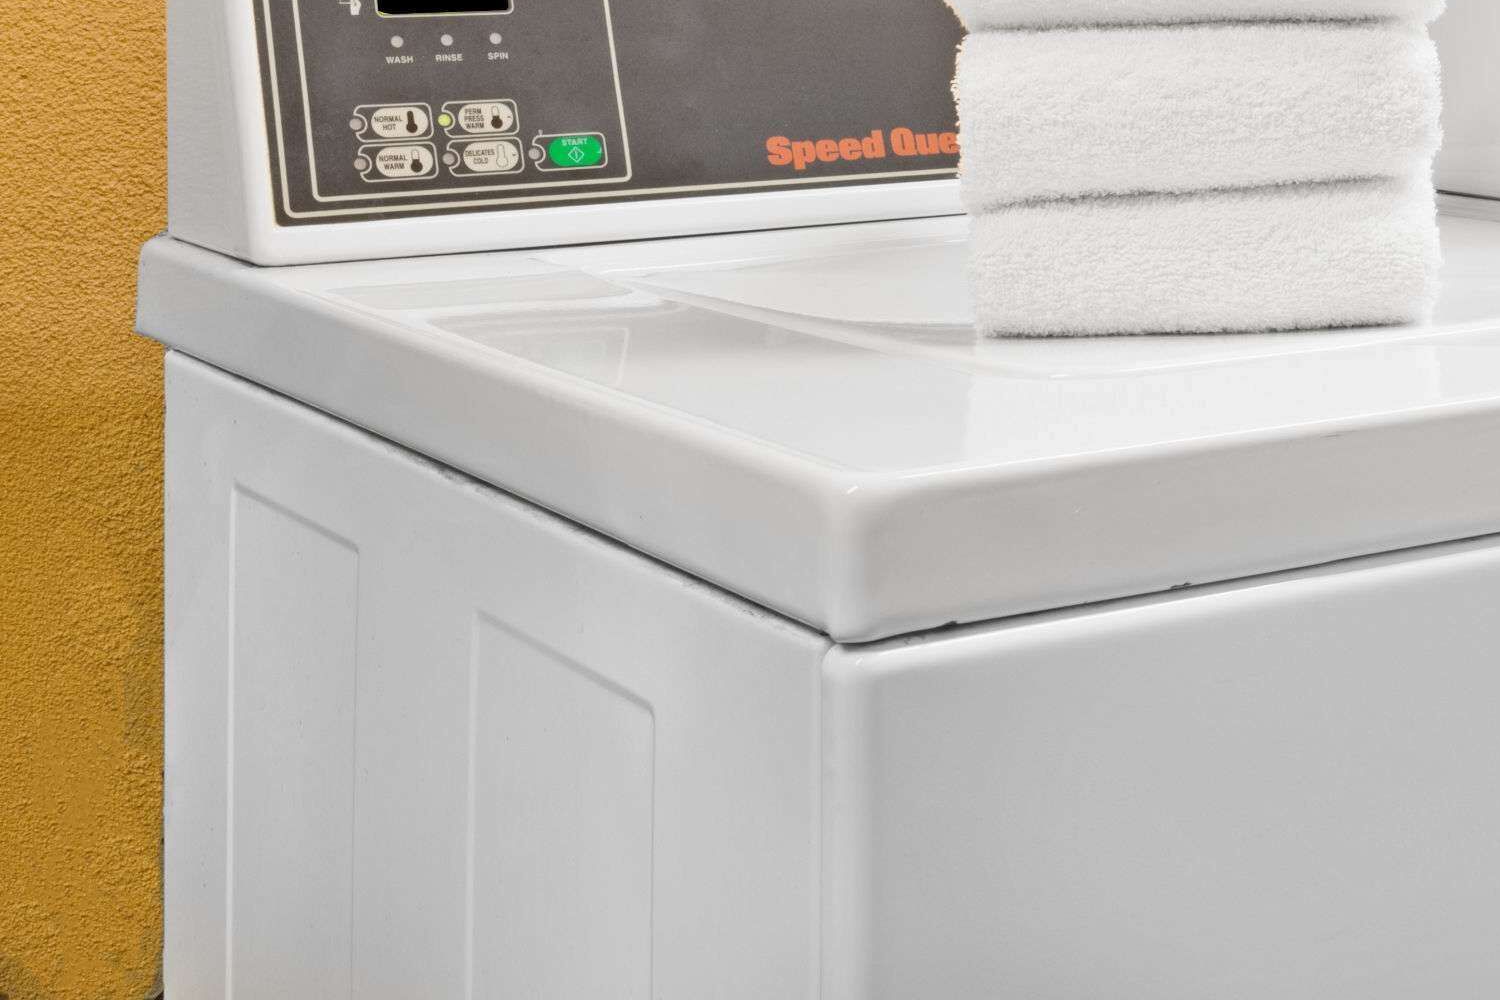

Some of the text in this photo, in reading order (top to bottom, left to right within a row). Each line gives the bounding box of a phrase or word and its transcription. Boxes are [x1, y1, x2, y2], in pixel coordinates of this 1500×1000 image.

[385, 55, 414, 64] WASH
[435, 53, 463, 62] RINSE
[487, 51, 509, 60] SPIN
[374, 115, 402, 123] NORMAL
[382, 123, 396, 131] HOT
[561, 137, 588, 146] START
[464, 148, 495, 157] DELICATES
[765, 127, 959, 170] Speed Que
[378, 154, 407, 162] NORMAL
[383, 162, 405, 170] WARM
